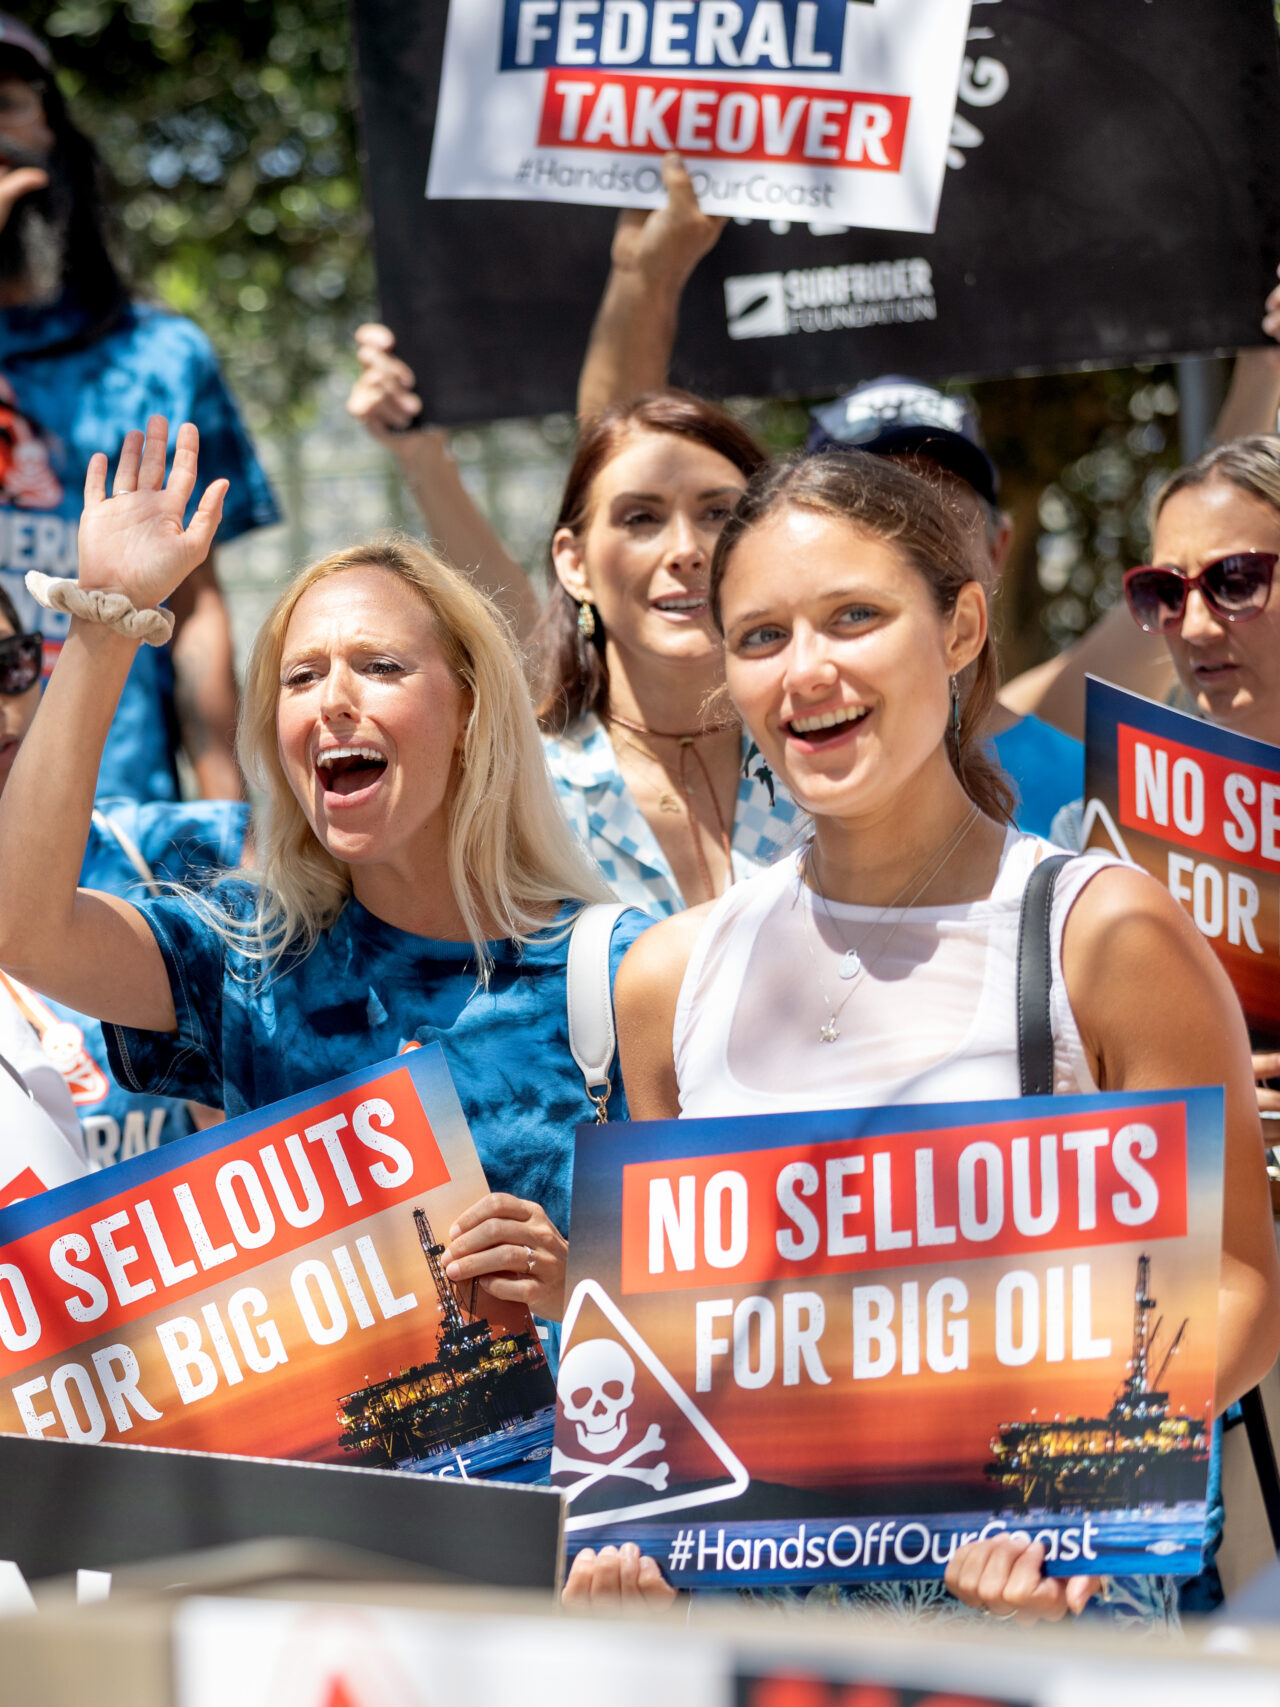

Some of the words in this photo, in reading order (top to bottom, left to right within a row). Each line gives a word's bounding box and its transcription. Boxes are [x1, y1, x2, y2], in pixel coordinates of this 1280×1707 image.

[514, 0, 833, 69] FEDERAL
[554, 80, 893, 166] TAKEOVER
[514, 157, 836, 208] #HandsOOurCoast
[783, 257, 935, 310] SURFRIDER
[1135, 741, 1205, 837] NO
[1168, 852, 1264, 954] FOR
[49, 1098, 414, 1322] SELLOUTS
[648, 1170, 749, 1274] NO
[776, 1123, 1159, 1262] SELLOUTS
[12, 1343, 163, 1443] FOR
[156, 1287, 289, 1405] BIG
[290, 1234, 418, 1346] OIL
[696, 1292, 831, 1393] FOR
[852, 1277, 969, 1380] BIG
[995, 1264, 1112, 1366] OIL
